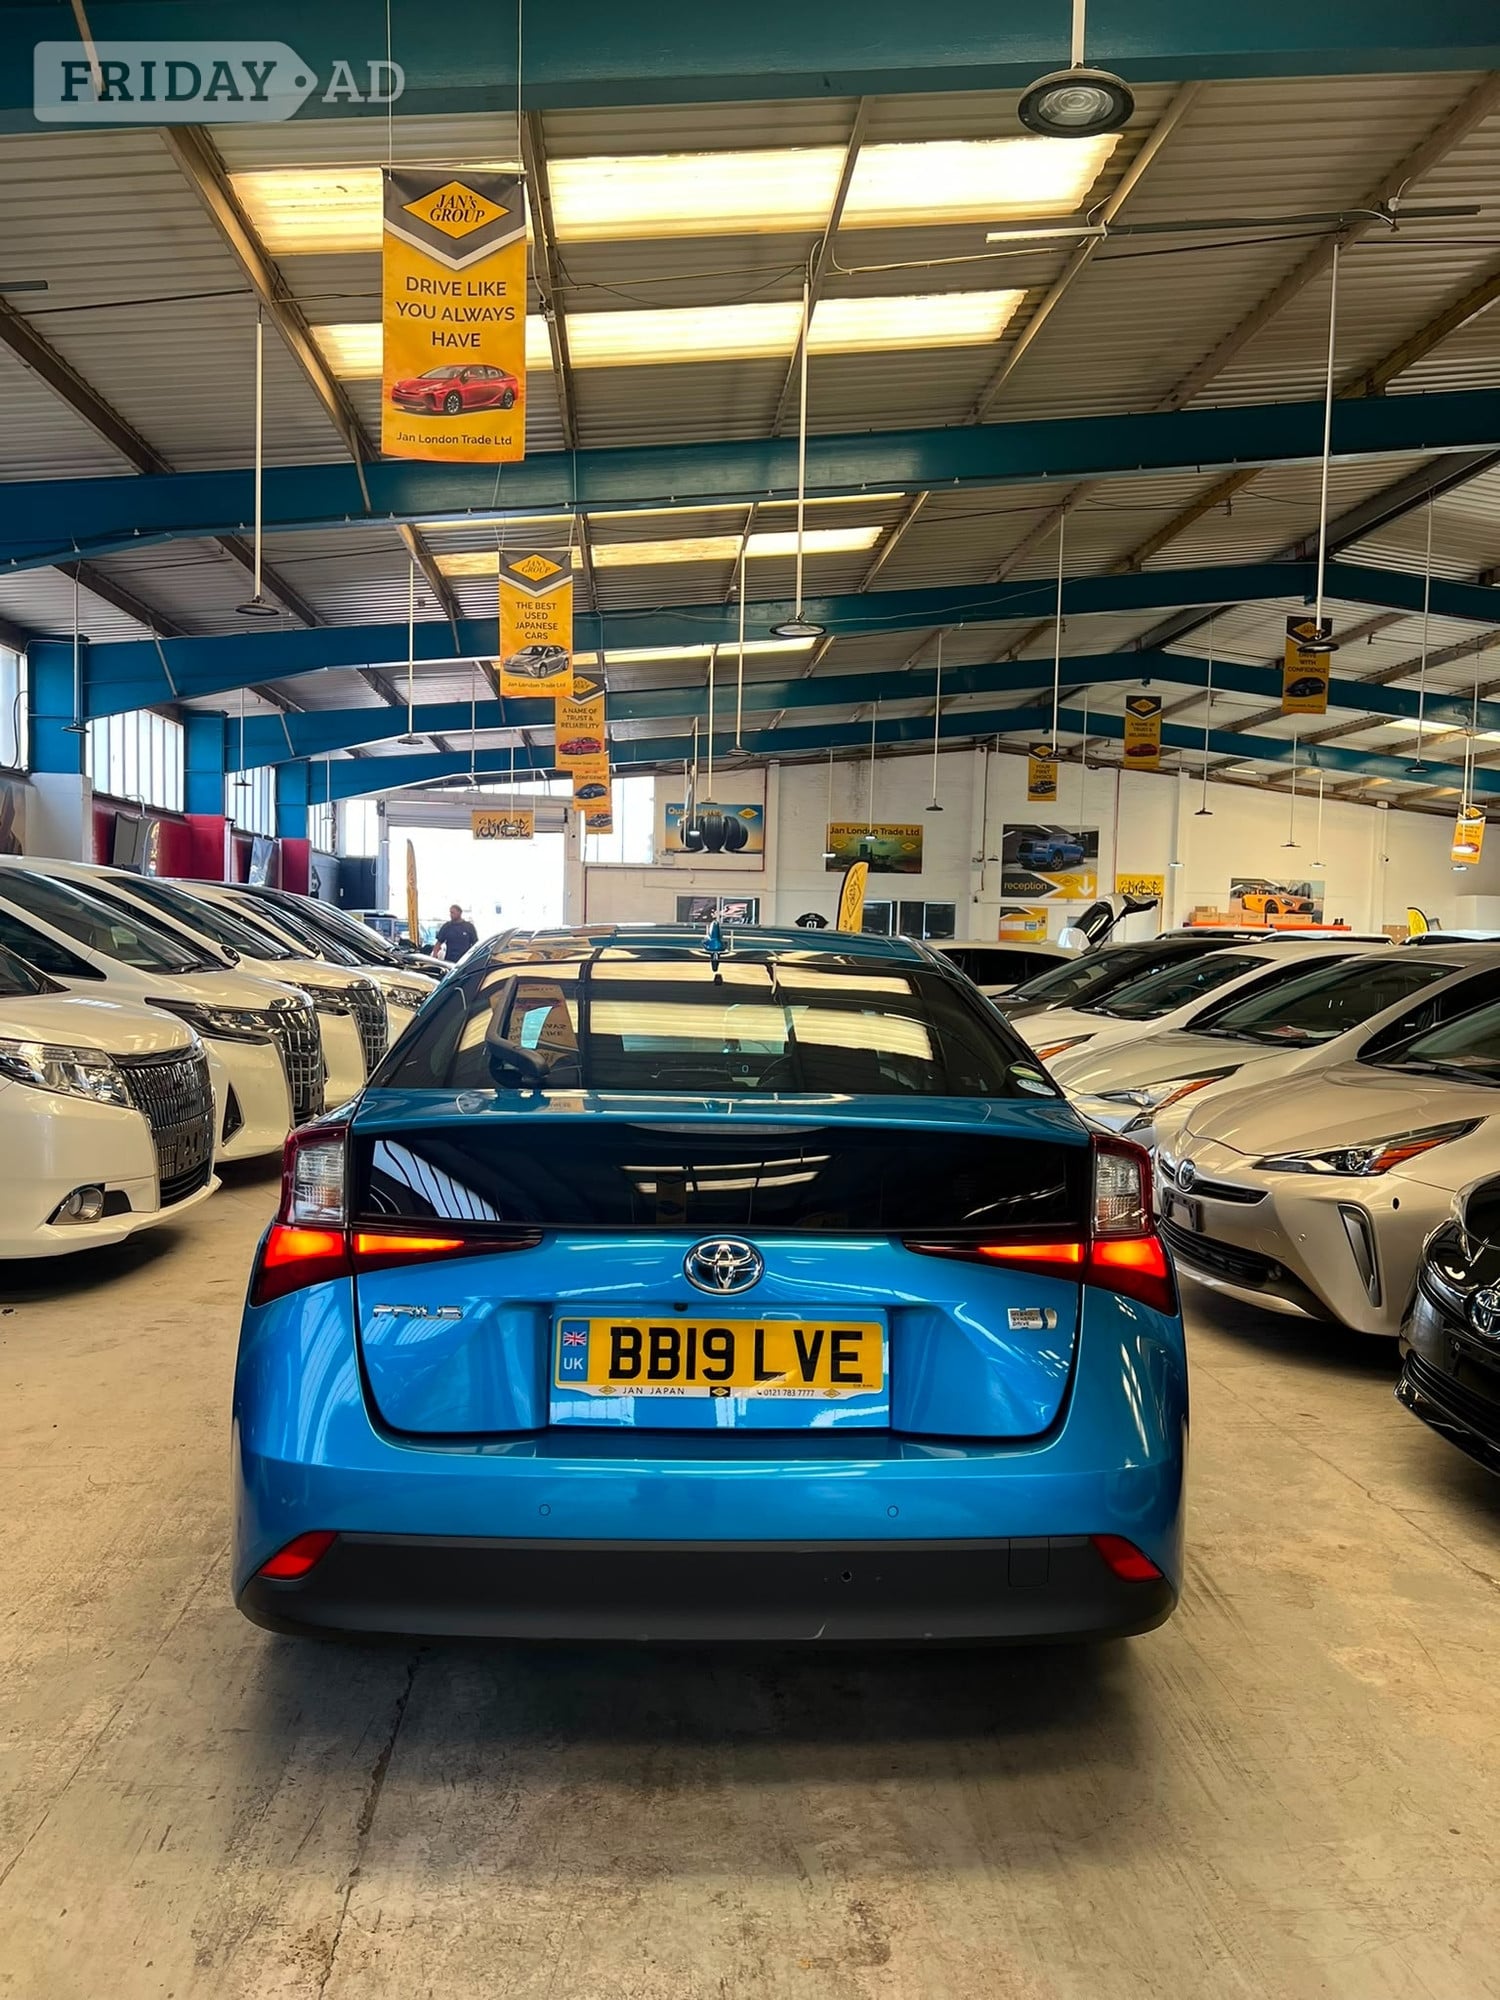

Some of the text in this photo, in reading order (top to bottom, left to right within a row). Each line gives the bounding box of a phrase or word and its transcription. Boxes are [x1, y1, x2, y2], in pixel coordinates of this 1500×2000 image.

[429, 208, 486, 224] GROUP
[406, 276, 507, 297] DRIVE LIKE
[395, 301, 516, 323] YOU ALWAYS
[432, 331, 482, 348] HAVE
[396, 431, 513, 446] Jan London Trade Ltd
[521, 566, 552, 575] GROUP
[516, 602, 557, 611] THE BEST
[524, 612, 549, 620] USED
[515, 622, 559, 631] JAPANESE
[524, 632, 549, 640] CARS
[830, 826, 920, 837] Jan London Trade Ltd
[1003, 882, 1048, 891] reception
[608, 1326, 863, 1383] BB19 LVE
[562, 1357, 584, 1370] UK
[622, 1387, 685, 1395] JAN JAPAN
[763, 1389, 781, 1397] 0121
[782, 1389, 797, 1397] 783
